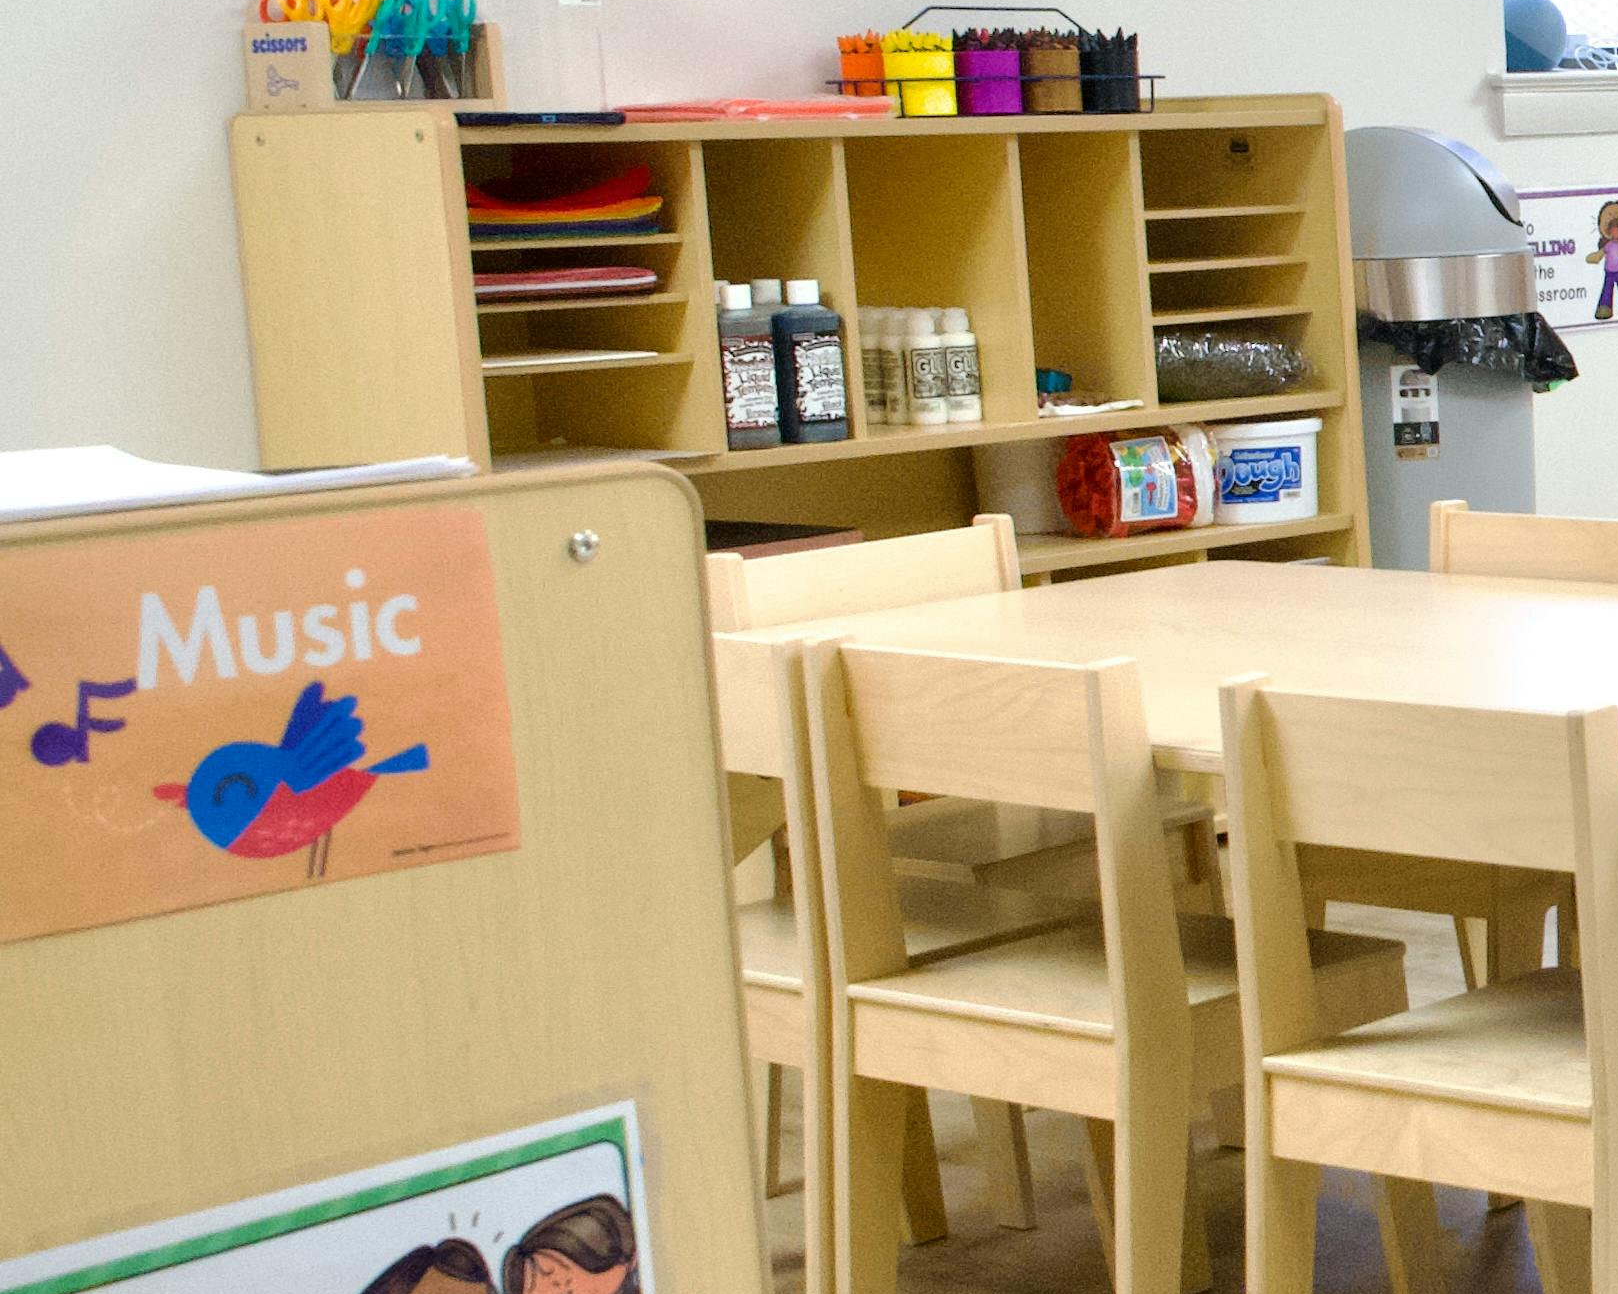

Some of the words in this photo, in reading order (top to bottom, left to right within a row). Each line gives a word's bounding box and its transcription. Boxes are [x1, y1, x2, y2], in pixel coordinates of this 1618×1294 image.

[251, 36, 307, 54] scissors
[1536, 287, 1587, 302] ssroom
[137, 568, 422, 689] Music
